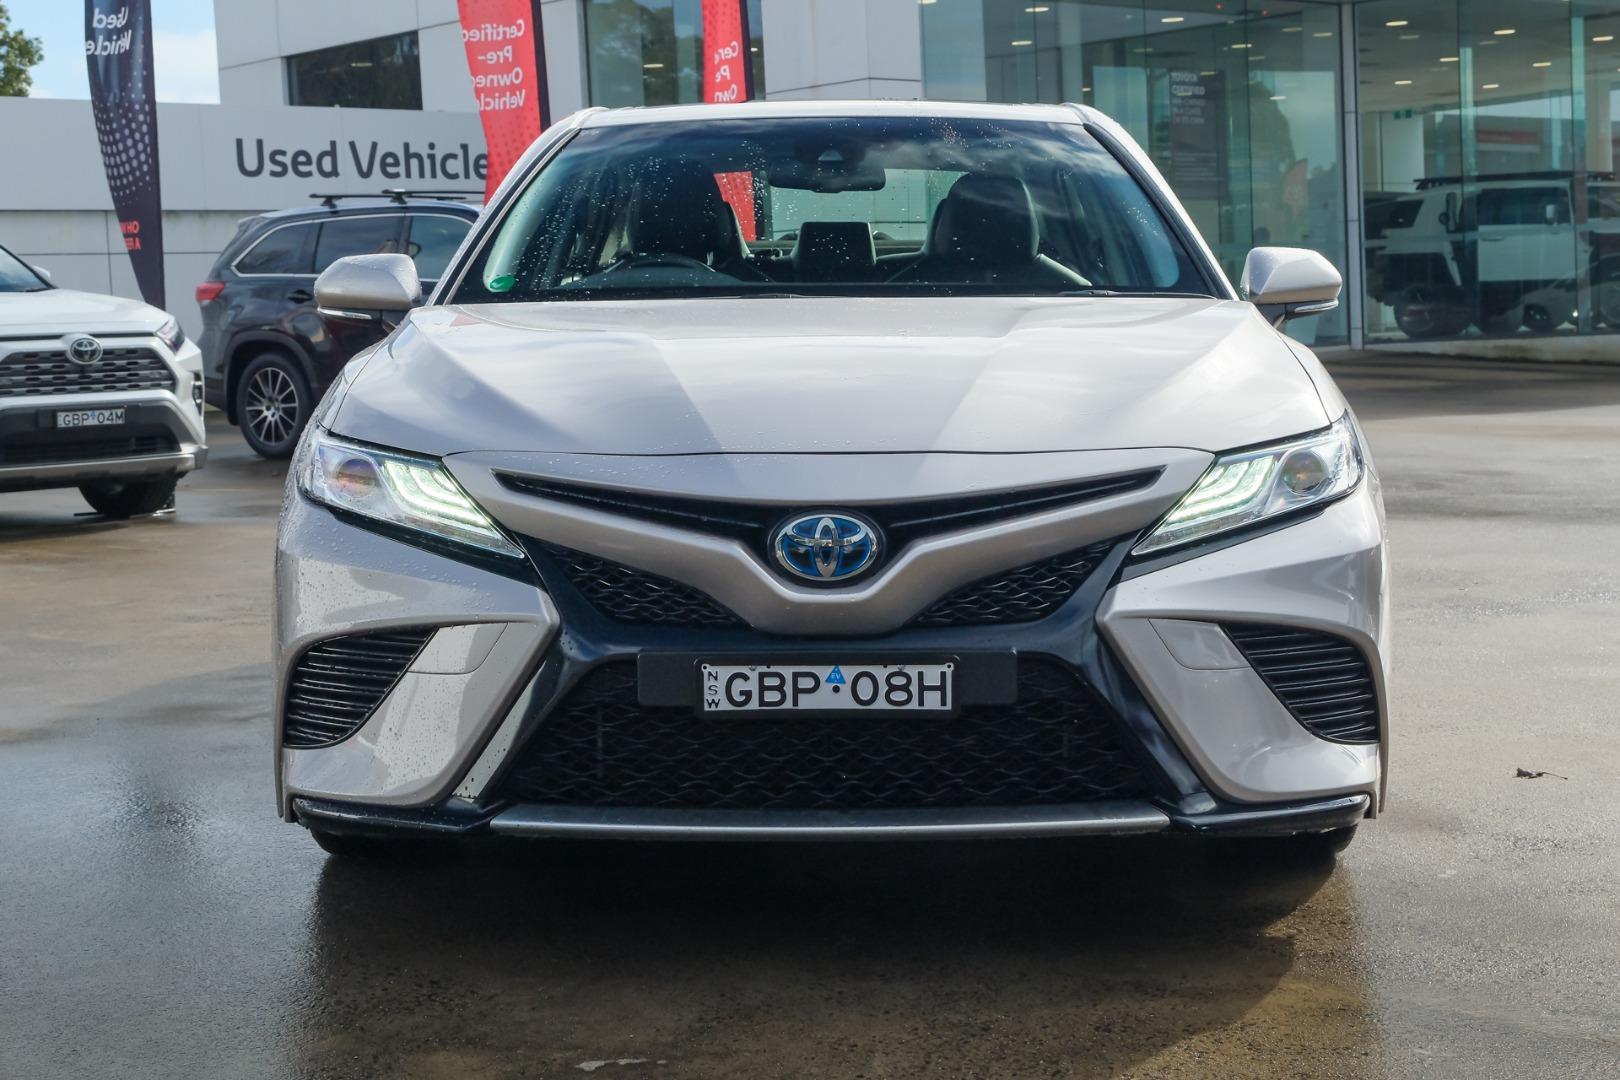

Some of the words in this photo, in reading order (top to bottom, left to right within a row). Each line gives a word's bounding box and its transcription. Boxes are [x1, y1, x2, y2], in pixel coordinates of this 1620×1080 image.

[235, 137, 340, 179] Used
[348, 140, 488, 181] Vehicle
[706, 669, 720, 709] NSW
[724, 670, 821, 708] GBP
[850, 670, 948, 708] 08H
